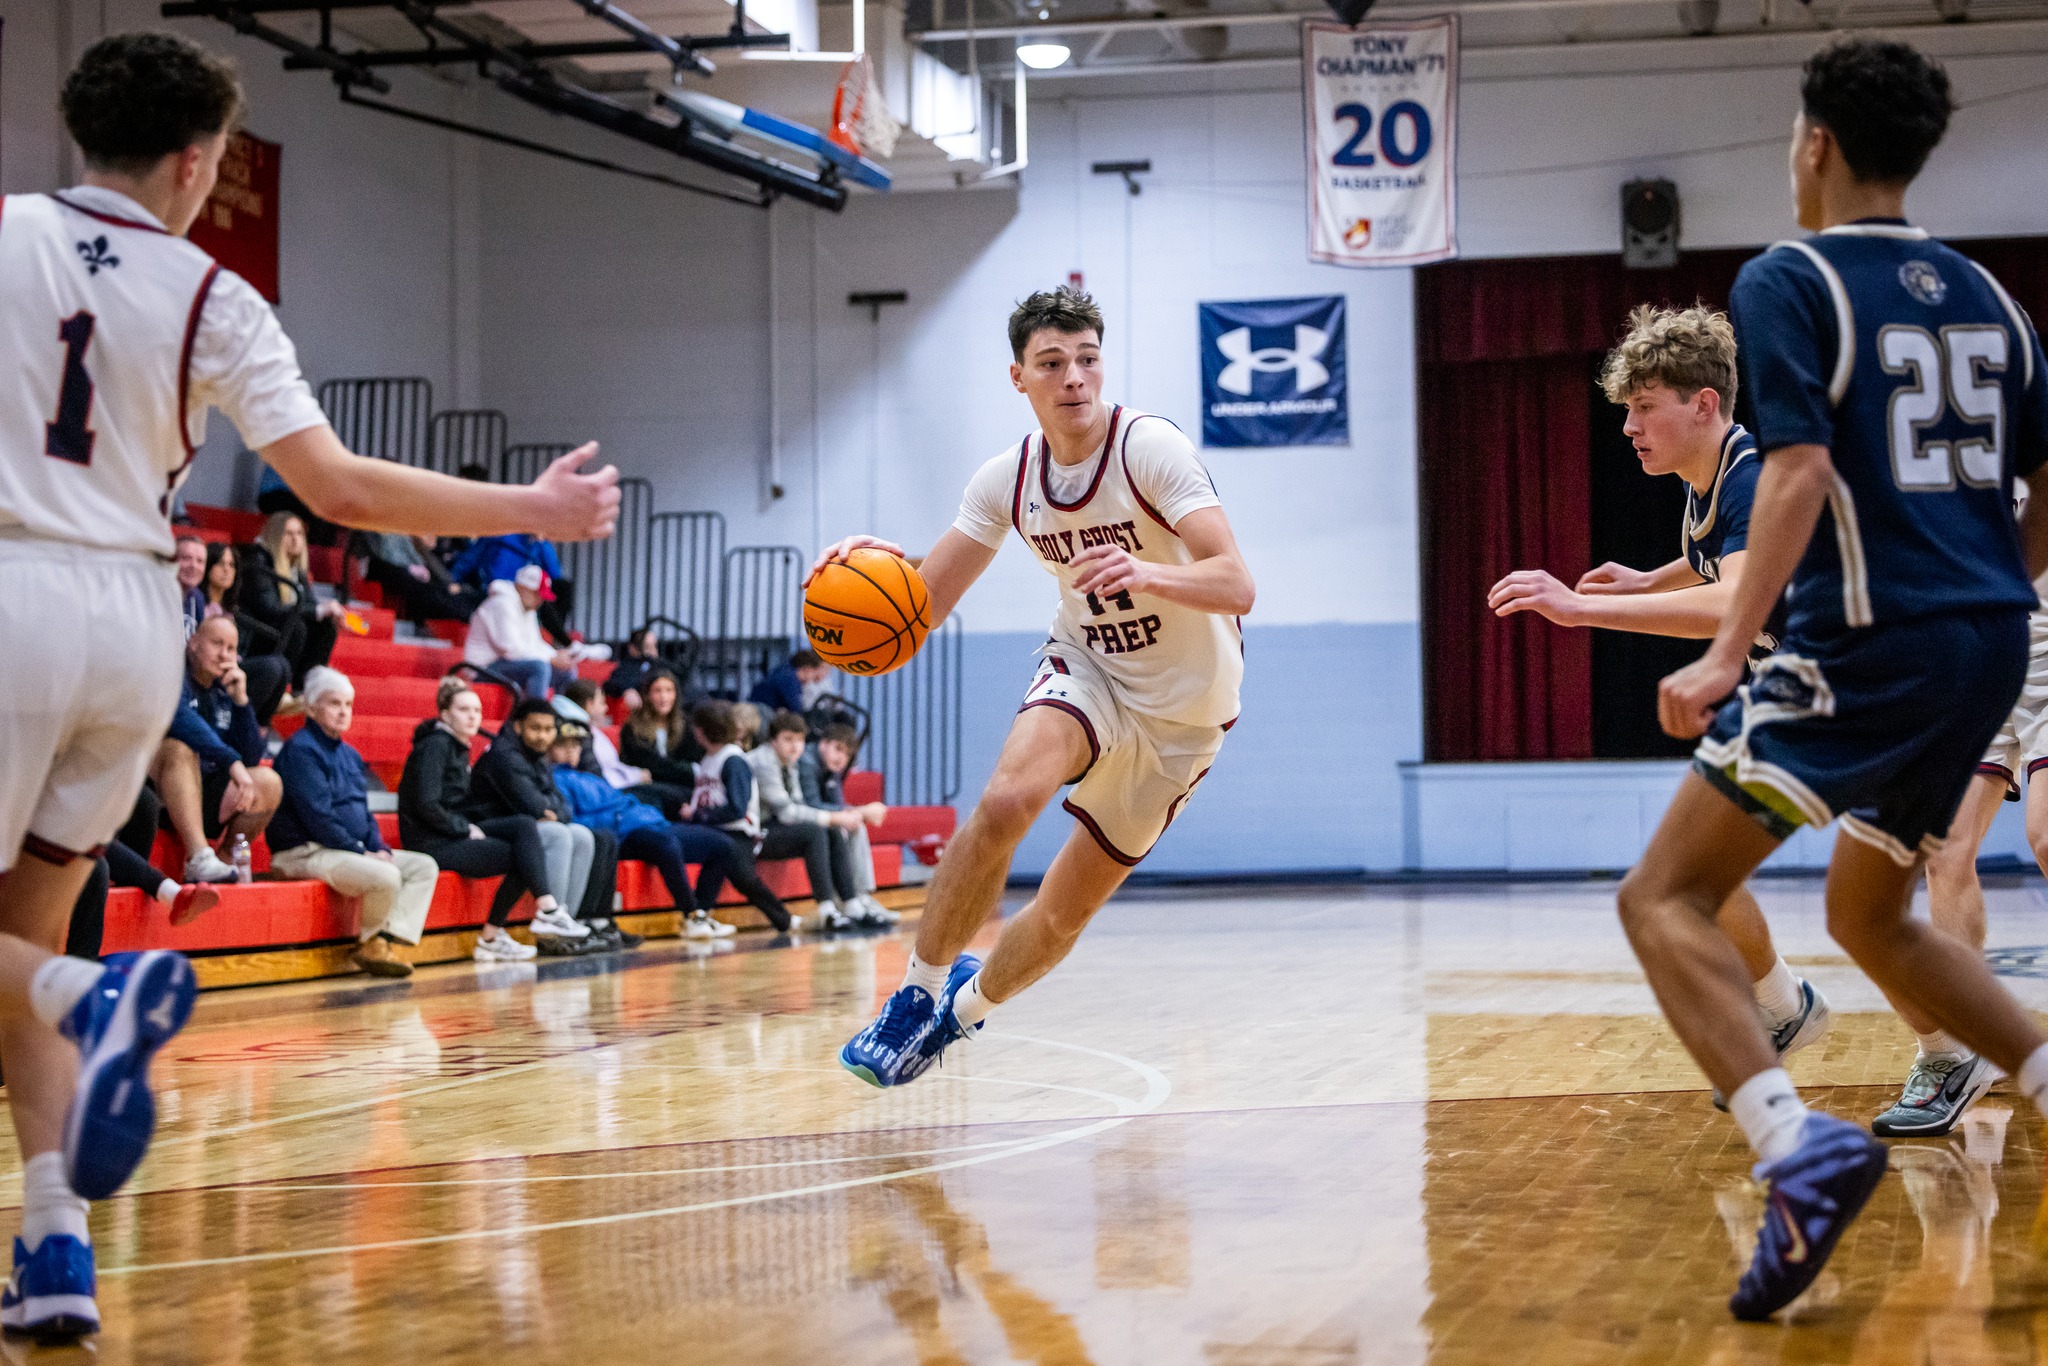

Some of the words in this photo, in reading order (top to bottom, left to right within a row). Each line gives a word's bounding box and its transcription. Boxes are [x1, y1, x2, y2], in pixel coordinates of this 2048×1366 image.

[1316, 56, 1417, 76] CHAPMAN
[1353, 35, 1408, 54] TONY
[1333, 101, 1432, 168] 20
[45, 308, 97, 467] 1
[1877, 323, 2009, 492] 25
[1030, 530, 1076, 565] HOLY
[1078, 520, 1144, 554] GHOST
[1080, 614, 1162, 655] PREP
